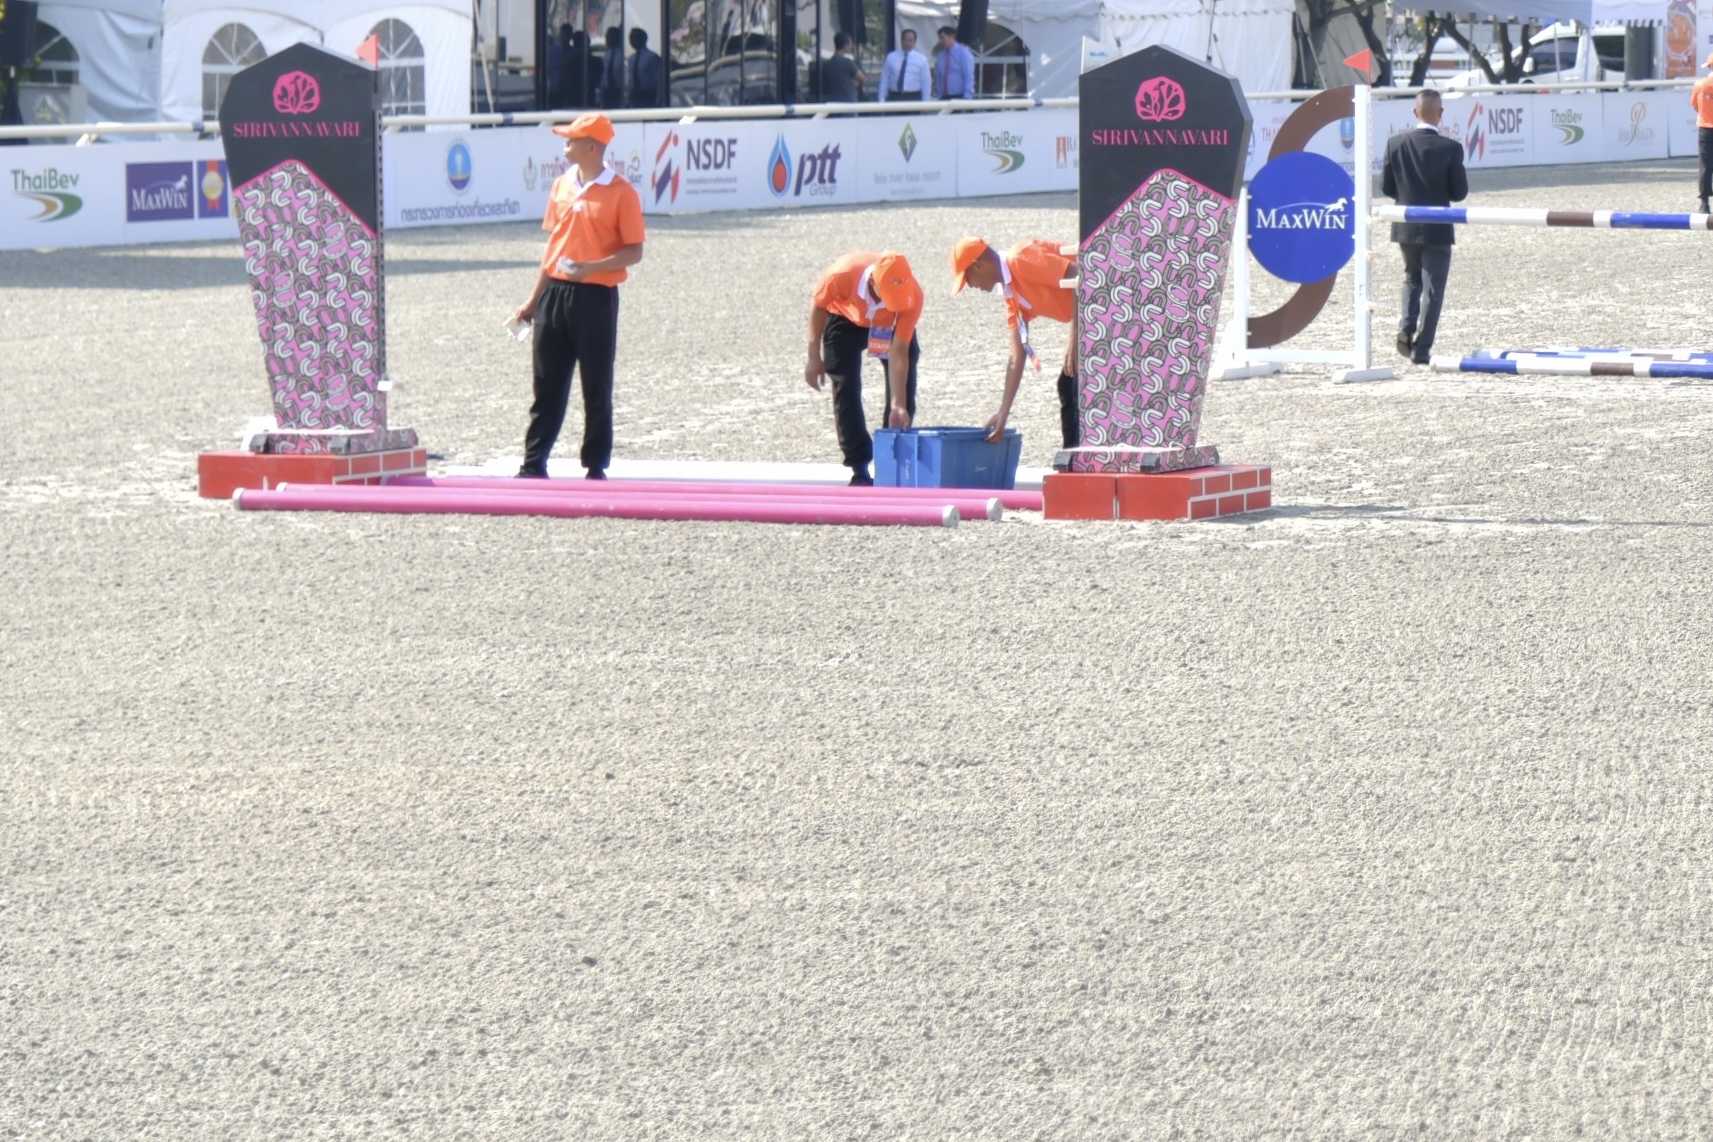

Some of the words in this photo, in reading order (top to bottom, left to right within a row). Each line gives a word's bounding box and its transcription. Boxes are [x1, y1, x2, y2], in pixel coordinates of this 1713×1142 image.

[1488, 107, 1523, 135] NSDF
[1550, 108, 1583, 124] ThaiBev
[233, 121, 361, 138] SIRIVANNAVARI
[1092, 129, 1229, 146] SIRIVANNAVARI
[981, 131, 1023, 149] ThaiBev
[686, 138, 738, 171] NSDF
[11, 168, 80, 191] ThaiBev
[794, 142, 842, 197] ptt
